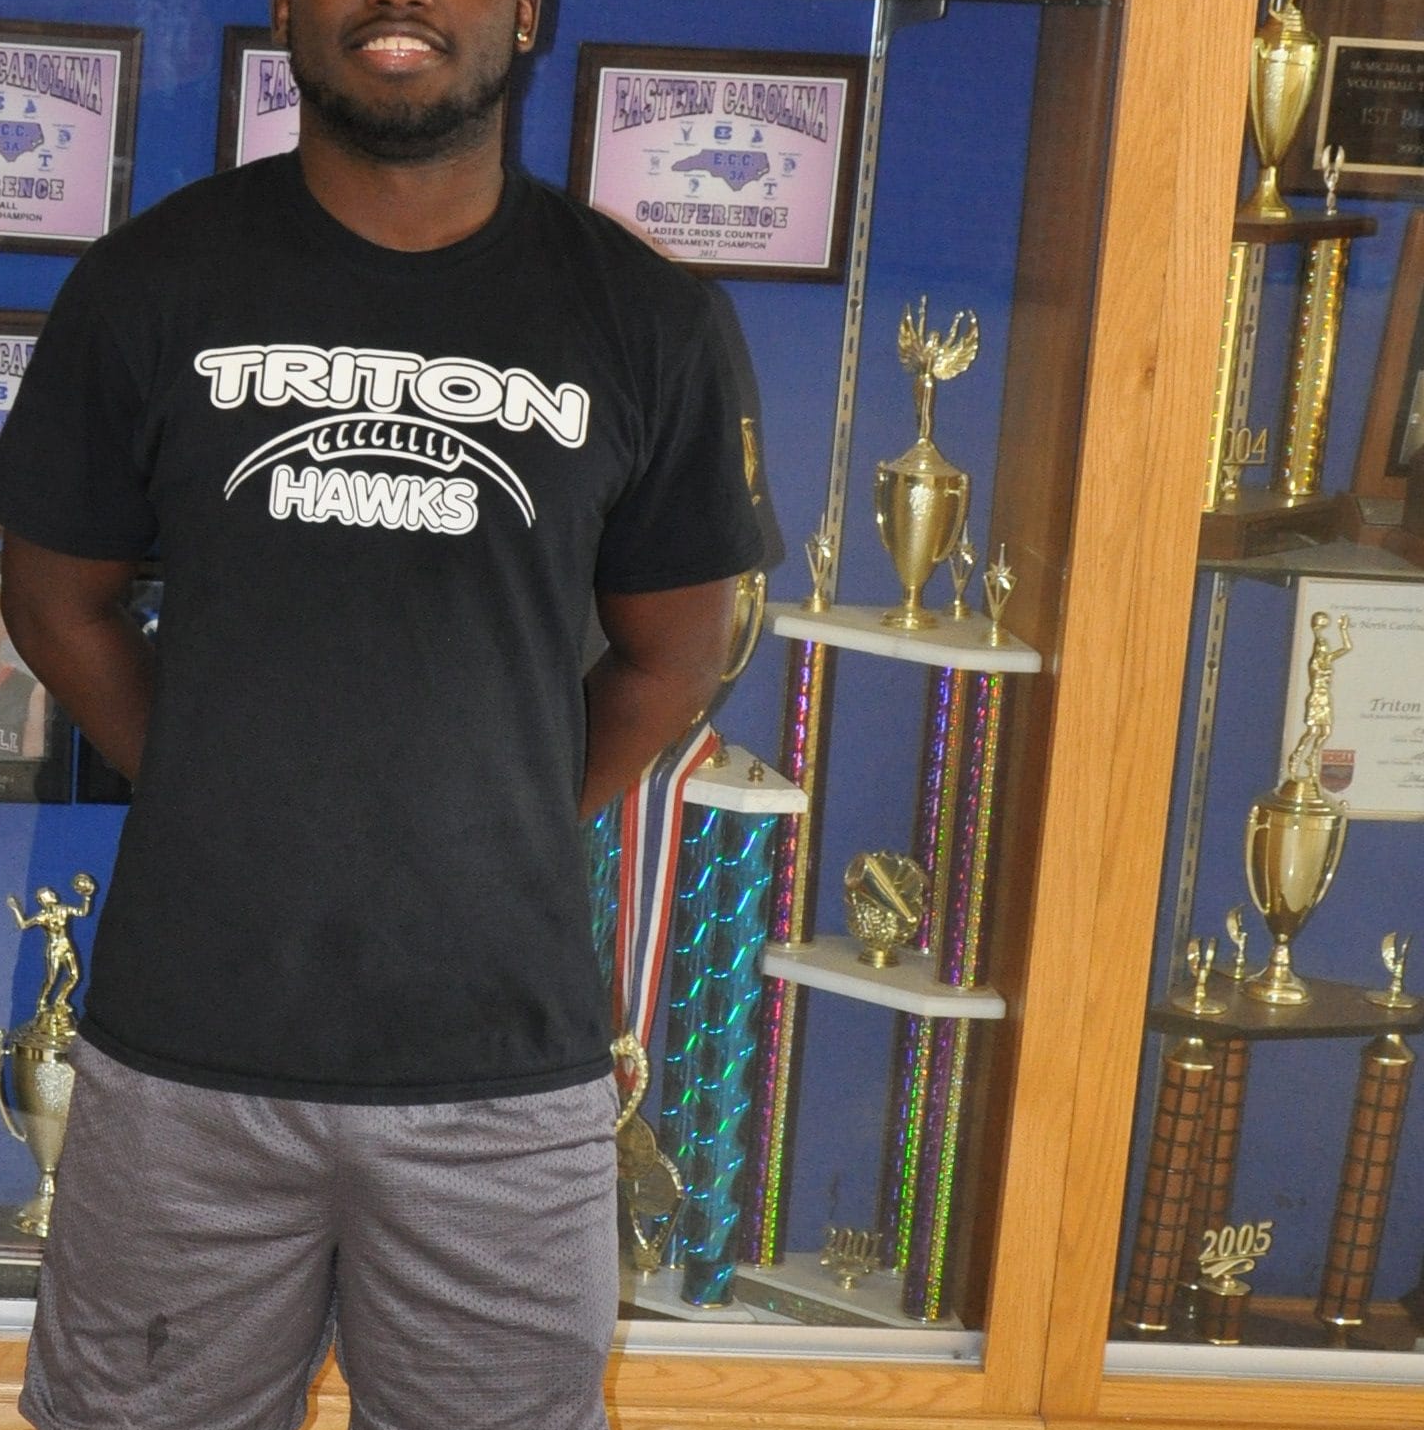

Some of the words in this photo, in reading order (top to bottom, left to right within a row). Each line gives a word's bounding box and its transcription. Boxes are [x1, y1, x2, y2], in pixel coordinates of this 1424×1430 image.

[612, 77, 717, 133] EASTERN
[722, 81, 829, 143] CAROLINA
[636, 200, 788, 228] CONFERENCE
[647, 227, 684, 237] LADIES
[688, 229, 721, 238] CROSS
[724, 230, 773, 240] COUNTRY
[652, 237, 715, 248] TOURNAMENT
[718, 239, 766, 249] CHAMPION
[194, 344, 590, 448] TRITON
[1224, 427, 1268, 463] 004
[269, 464, 478, 535] HAWKS
[1370, 698, 1421, 712] Triton
[1199, 1221, 1272, 1260] 2005
